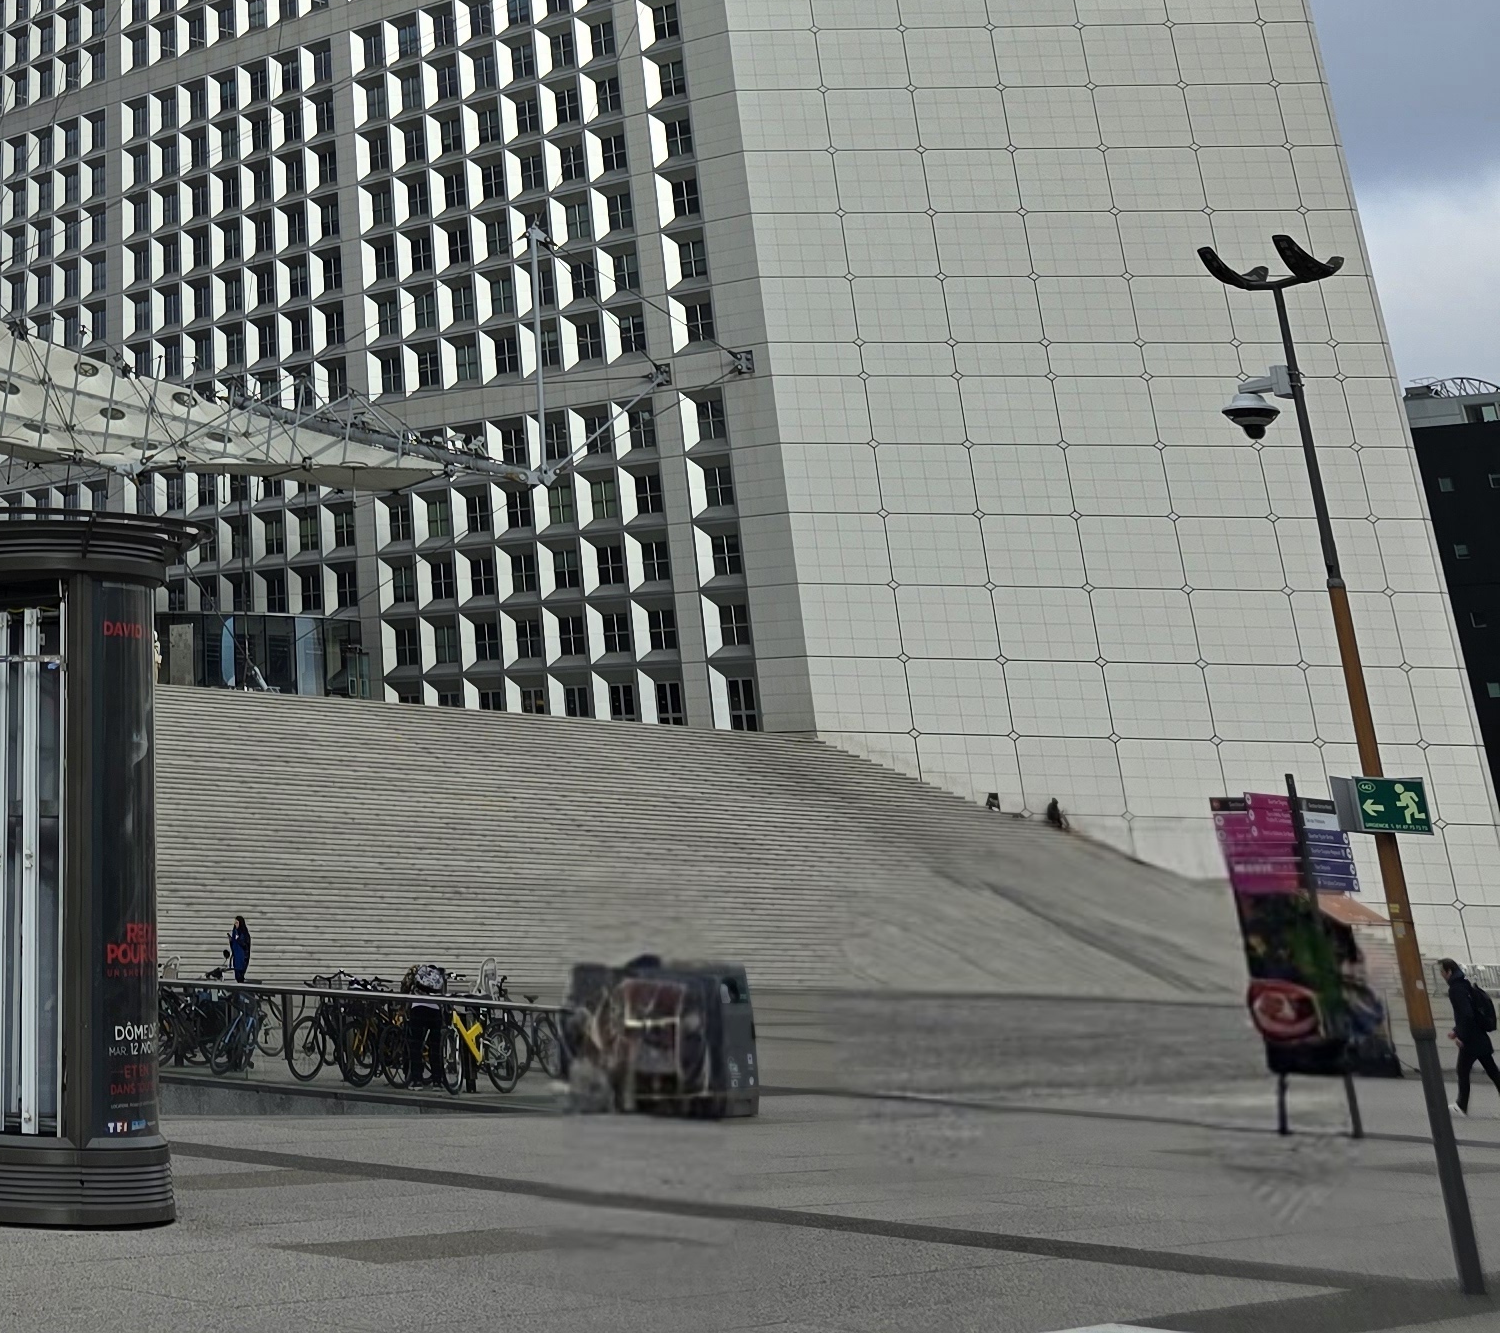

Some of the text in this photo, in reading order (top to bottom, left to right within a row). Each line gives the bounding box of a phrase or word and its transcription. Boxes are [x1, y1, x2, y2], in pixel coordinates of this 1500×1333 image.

[103, 620, 143, 640] DAVID
[114, 1021, 148, 1041] DÔME
[130, 1042, 138, 1055] 12
[110, 1083, 136, 1095] DANS
